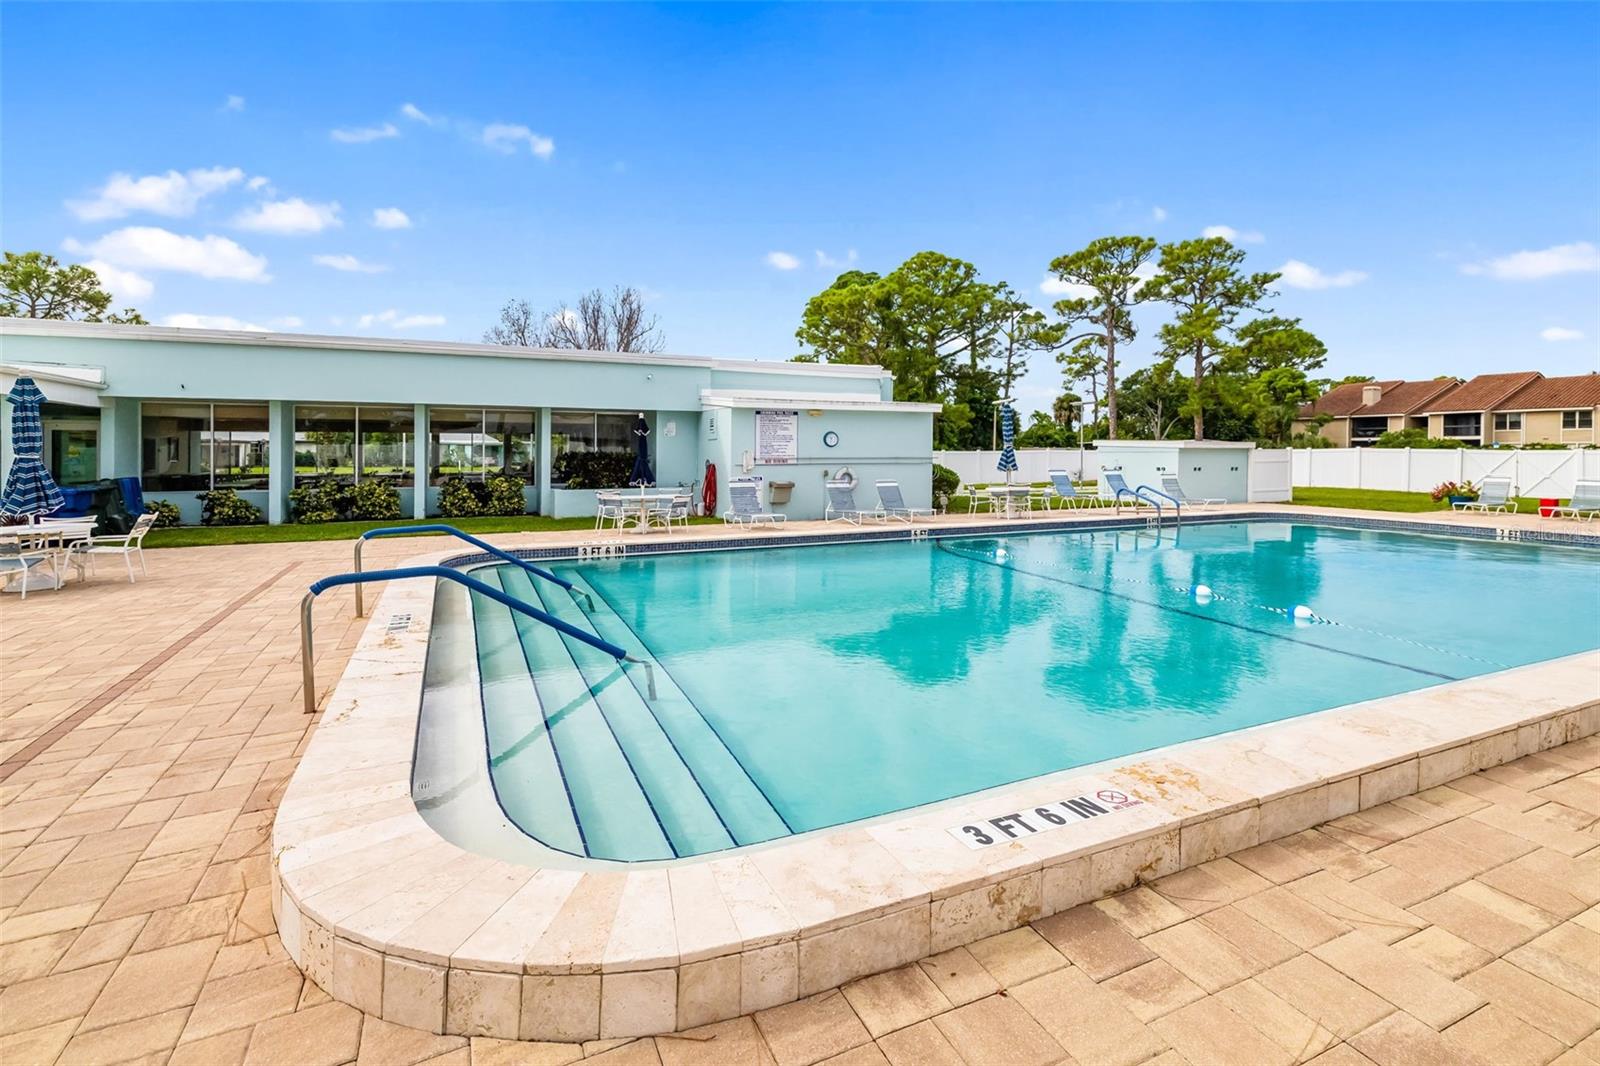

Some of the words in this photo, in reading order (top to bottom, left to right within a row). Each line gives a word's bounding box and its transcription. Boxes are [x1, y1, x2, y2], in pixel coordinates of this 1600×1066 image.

[582, 547, 588, 556] 3
[591, 546, 602, 555] FT
[605, 546, 611, 555] 6
[614, 545, 624, 554] IN
[961, 825, 995, 845] 3
[988, 813, 1038, 838] FT
[1034, 807, 1067, 826] 6
[1059, 797, 1110, 819] IN
